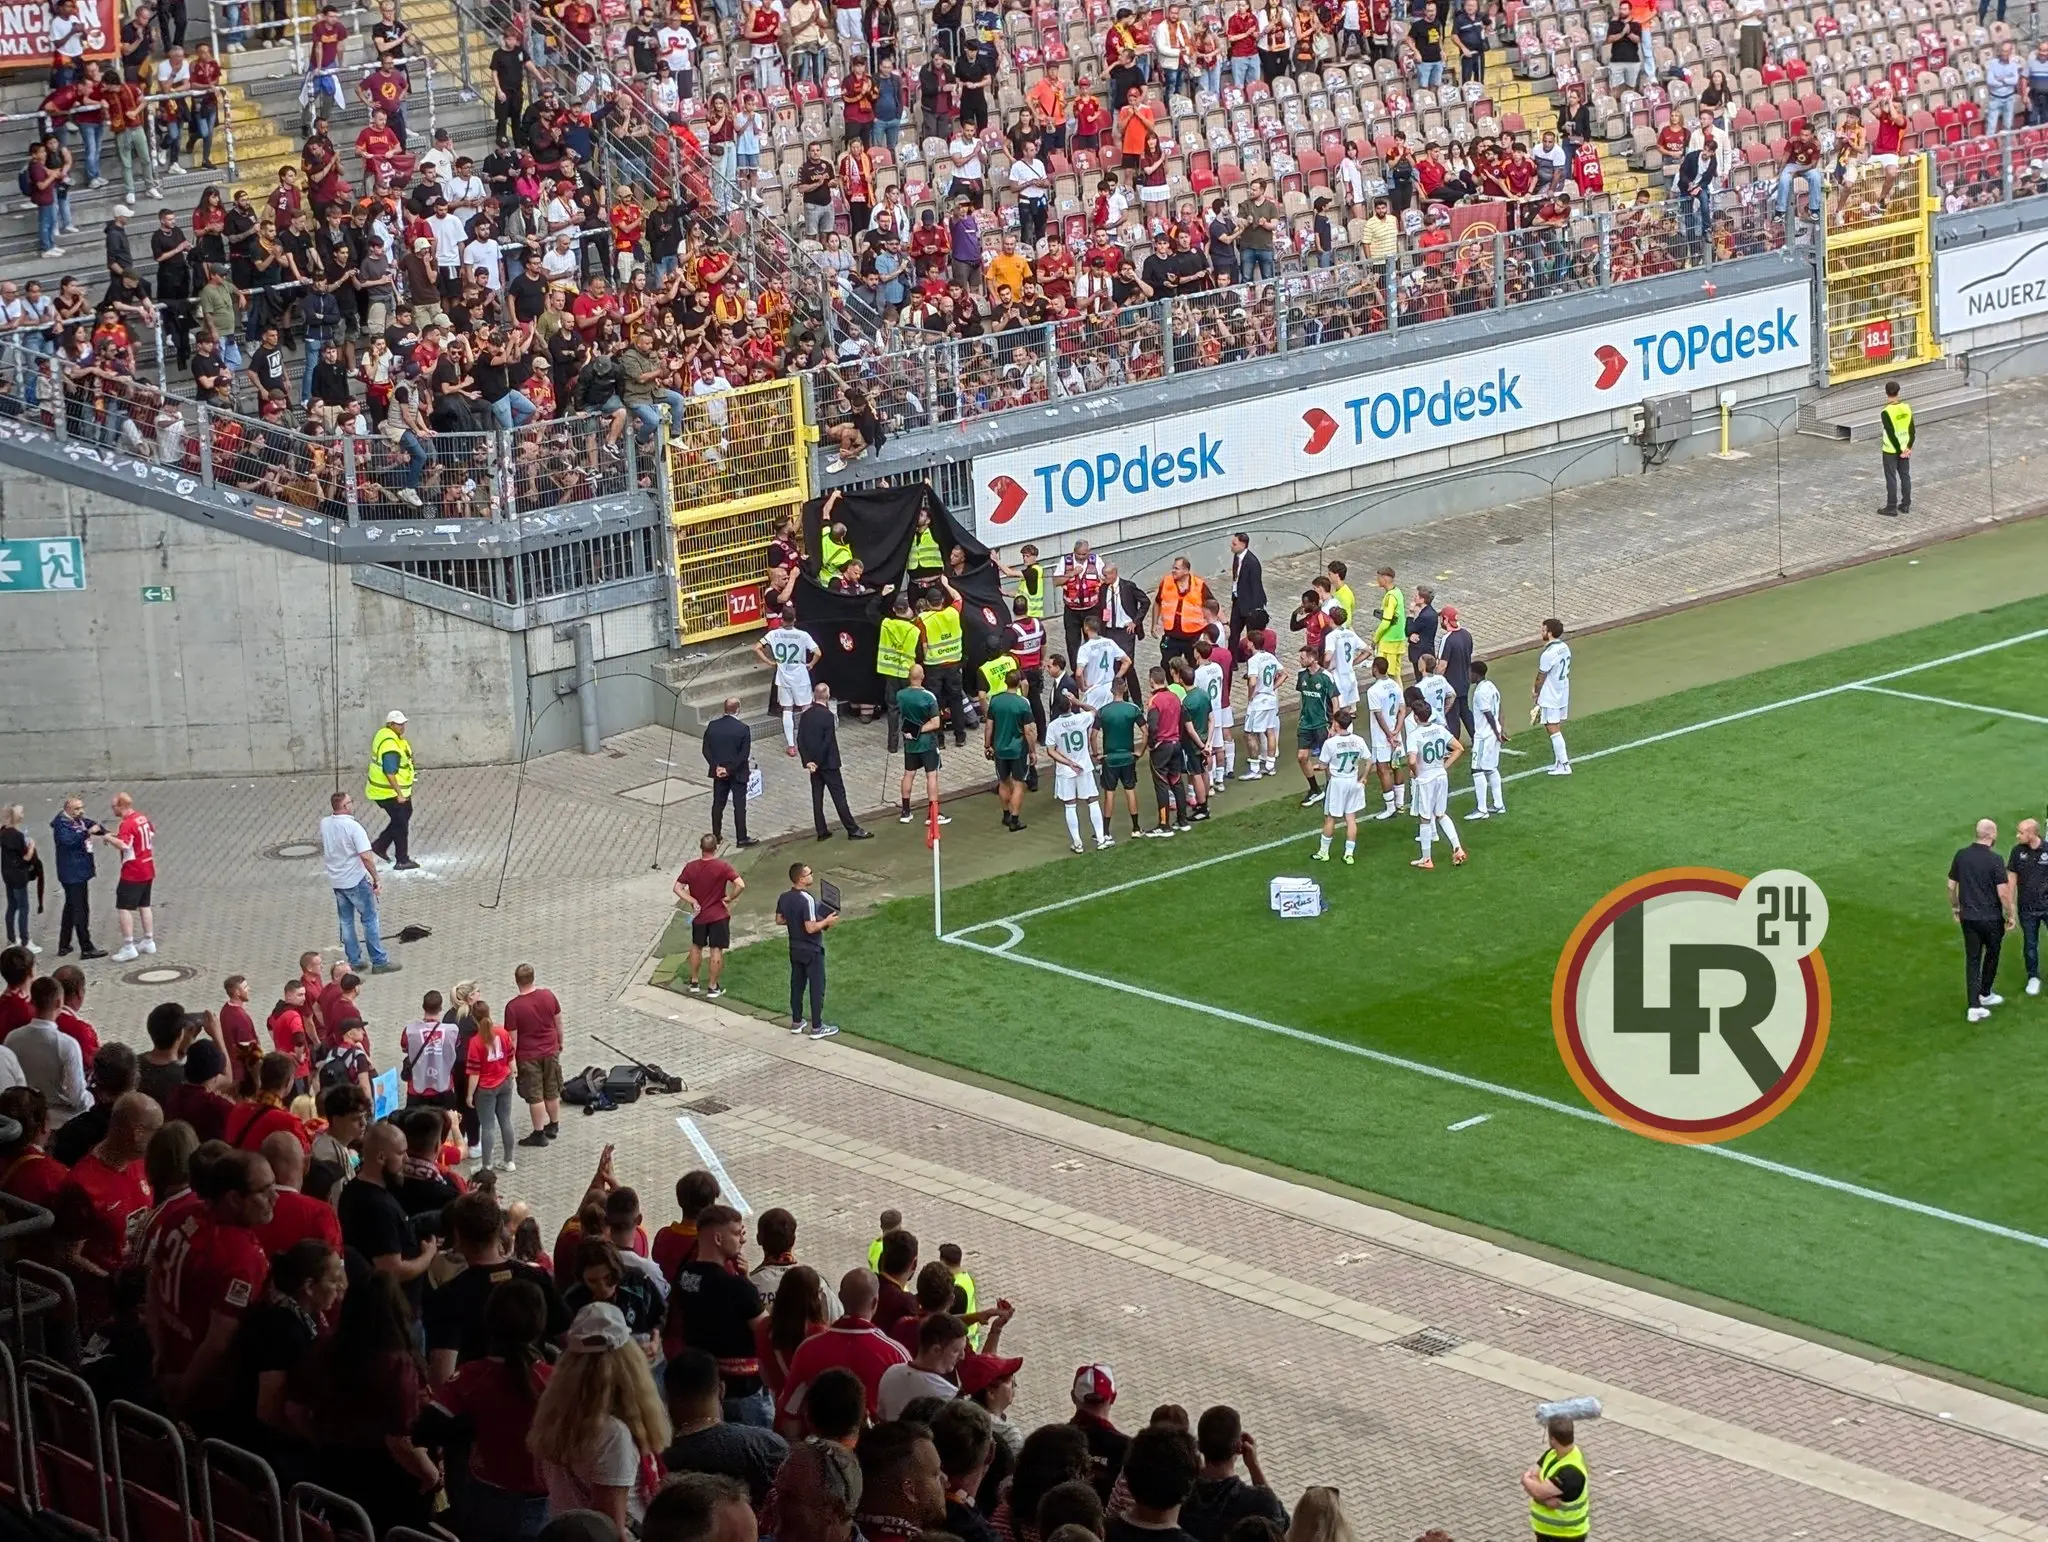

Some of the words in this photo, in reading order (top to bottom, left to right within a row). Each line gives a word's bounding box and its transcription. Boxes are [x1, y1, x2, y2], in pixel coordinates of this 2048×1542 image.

[0, 0, 101, 35] NCN
[0, 37, 33, 56] MA
[1969, 279, 2046, 316] NAUERZ
[1633, 307, 1800, 381] TOPdesk
[1866, 330, 1889, 348] 18.1
[1344, 368, 1523, 445] TOPdesk
[1034, 432, 1226, 513] TOPdesk
[731, 593, 758, 614] 17.1
[775, 642, 800, 664] 92
[1099, 650, 1109, 673] 4
[1060, 731, 1084, 754] 19
[1422, 738, 1446, 764] 60
[1336, 751, 1360, 773] 77
